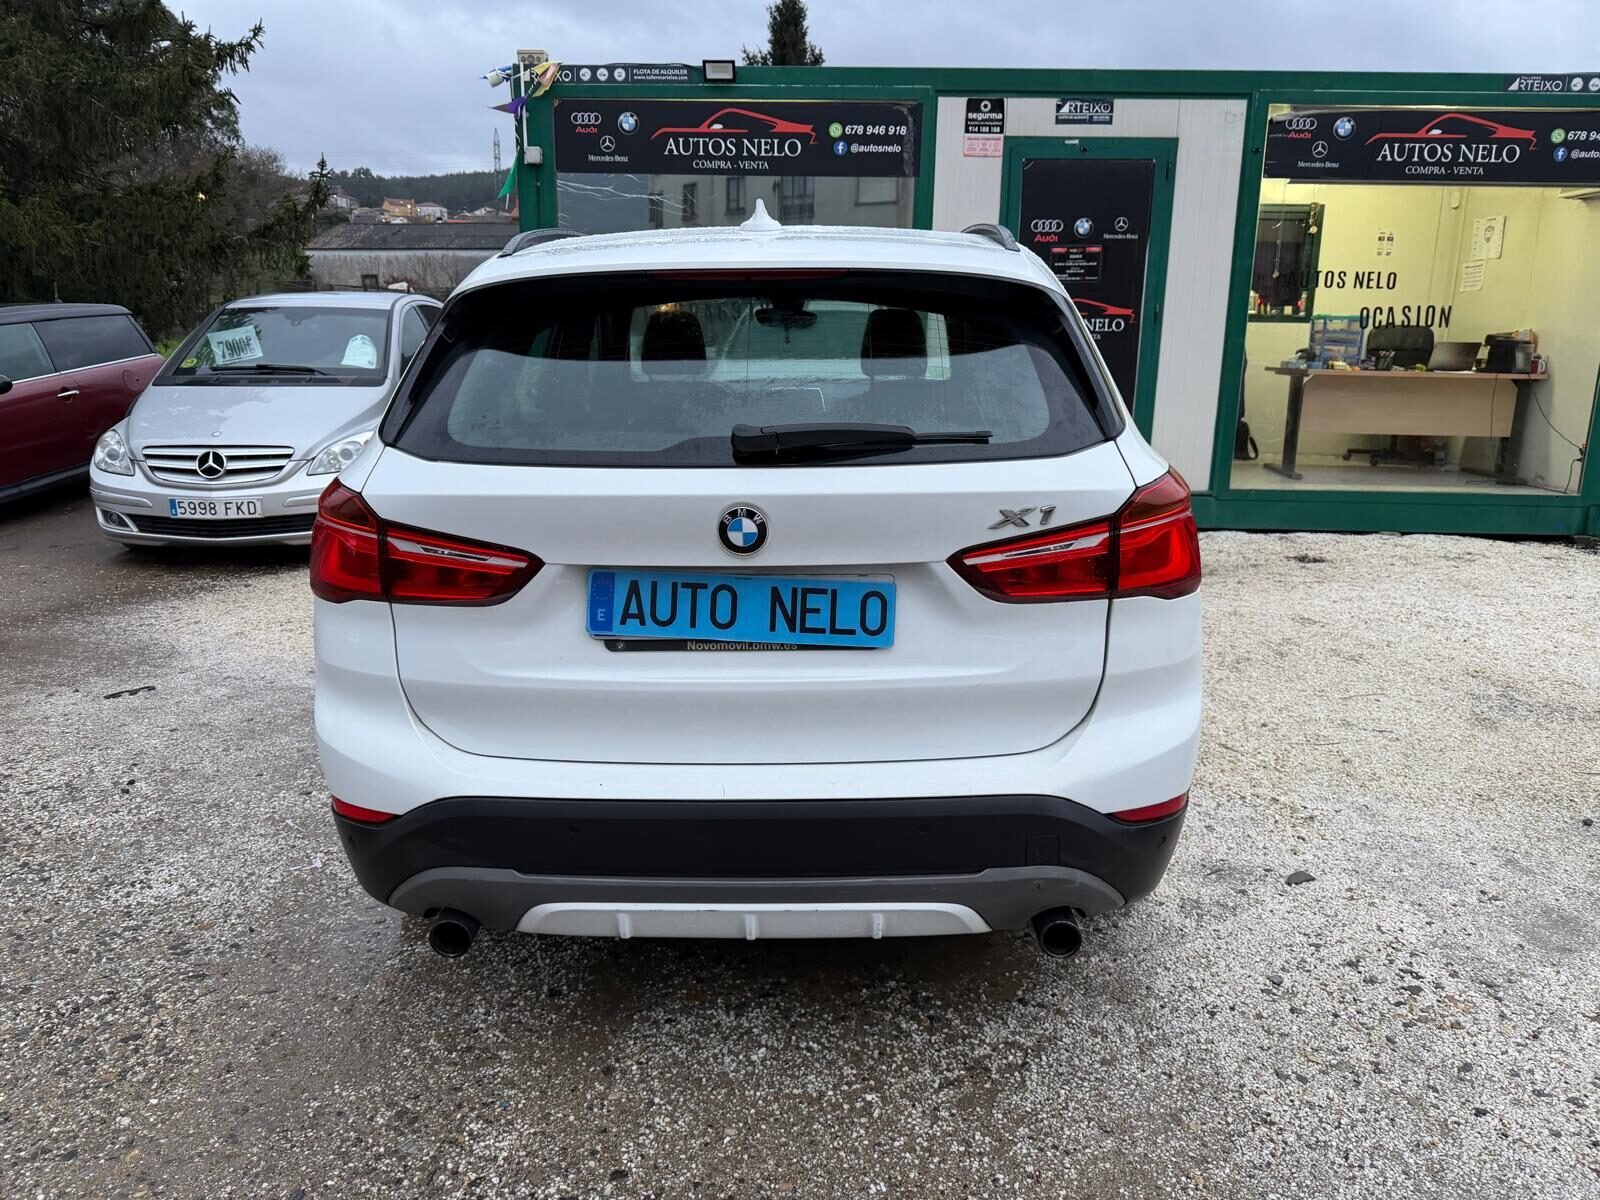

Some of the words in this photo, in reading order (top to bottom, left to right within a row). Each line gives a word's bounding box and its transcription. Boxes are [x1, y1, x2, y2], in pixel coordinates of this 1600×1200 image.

[968, 112, 1003, 120] segurma
[845, 125, 864, 135] 678
[866, 125, 886, 135] 946
[888, 125, 907, 136] 918
[1287, 131, 1312, 139] Audi
[1567, 130, 1588, 141] 678
[664, 137, 736, 157] AUTOS
[742, 138, 802, 157] NELO
[850, 143, 902, 153] @autosnelo
[588, 154, 629, 162] Mercedes-Benz
[1376, 143, 1453, 163] AUTOS
[1458, 143, 1521, 164] NELO
[1570, 148, 1600, 159] @auto
[693, 160, 732, 169] COMPRA
[738, 160, 769, 170] VENTA
[1297, 160, 1340, 168] Mercedes-Benz
[1405, 165, 1446, 175] COMPRA
[1453, 166, 1484, 176] VENTA
[1034, 234, 1059, 242] Audi
[1287, 270, 1347, 289] AUTOS
[1353, 271, 1398, 290] NELO
[1359, 304, 1453, 329] OCASION
[177, 501, 218, 516] 5998
[224, 501, 257, 515] FKD
[987, 504, 1057, 530] X1
[619, 578, 738, 631] AUTO
[768, 585, 889, 637] NELO
[597, 608, 606, 622] E
[686, 638, 799, 651] Novomovil.bmw.es
